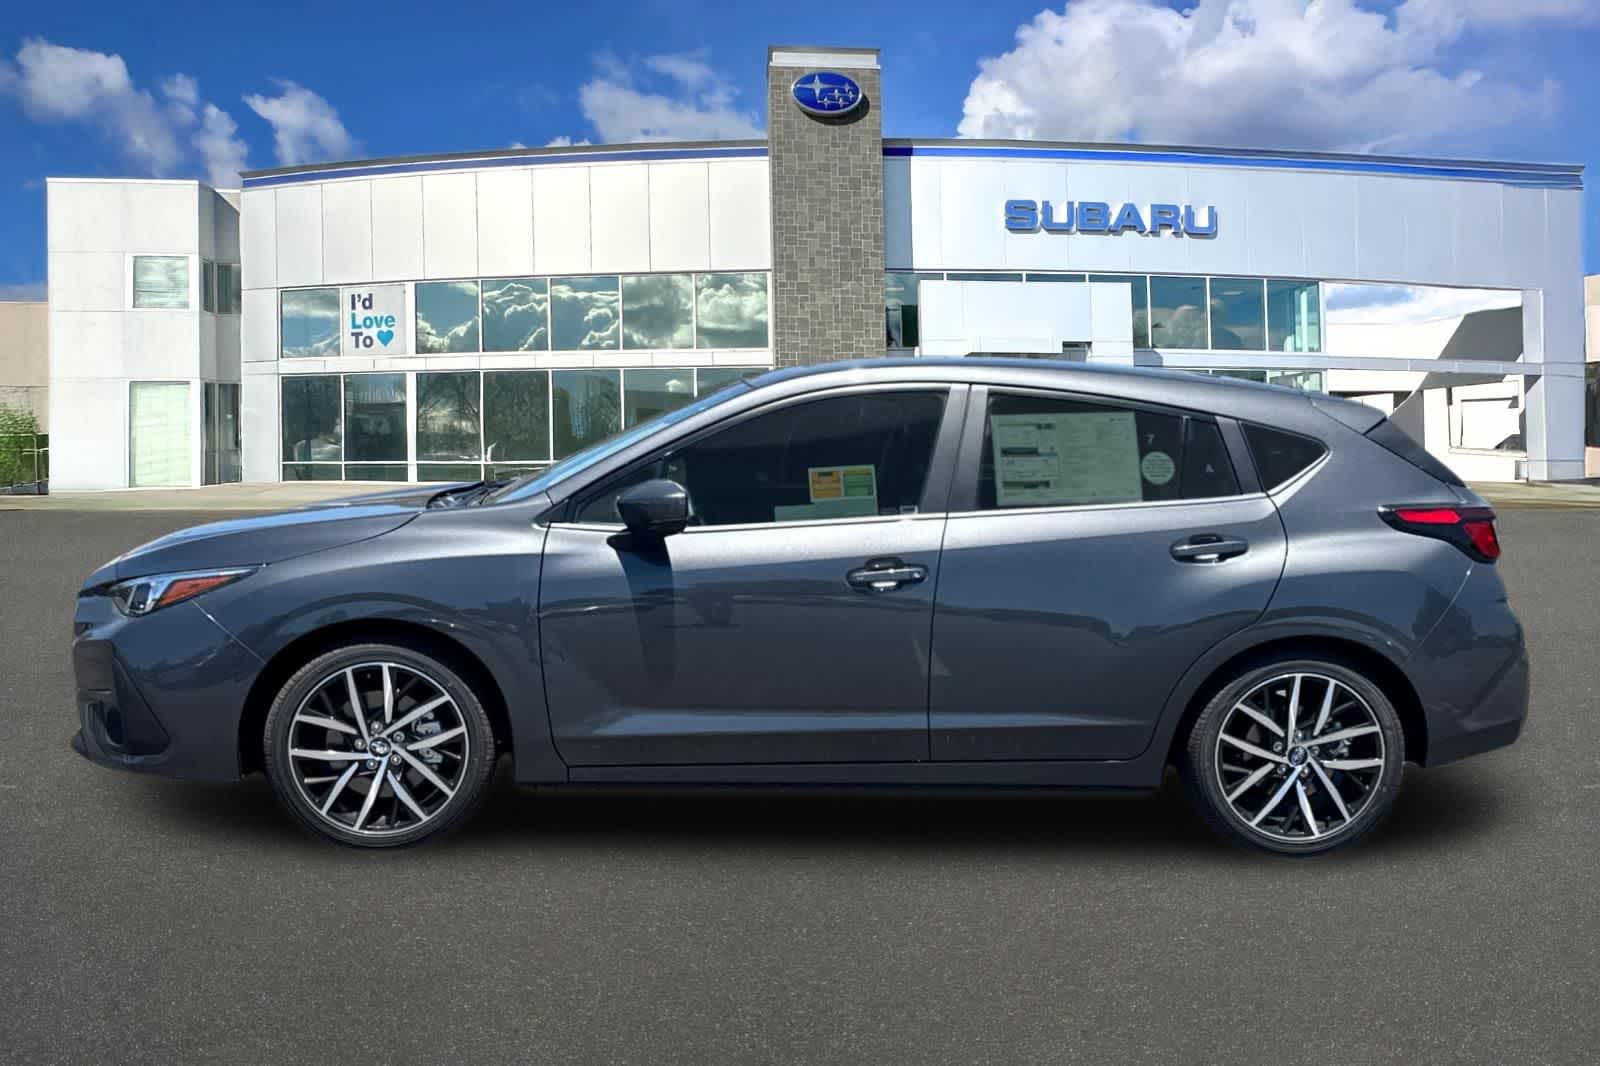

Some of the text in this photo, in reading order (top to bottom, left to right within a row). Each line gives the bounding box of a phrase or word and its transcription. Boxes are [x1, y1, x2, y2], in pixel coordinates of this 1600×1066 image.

[1004, 199, 1217, 237] SUBARU
[351, 293, 373, 310] I’d
[351, 312, 396, 329] Love
[351, 332, 374, 349] To
